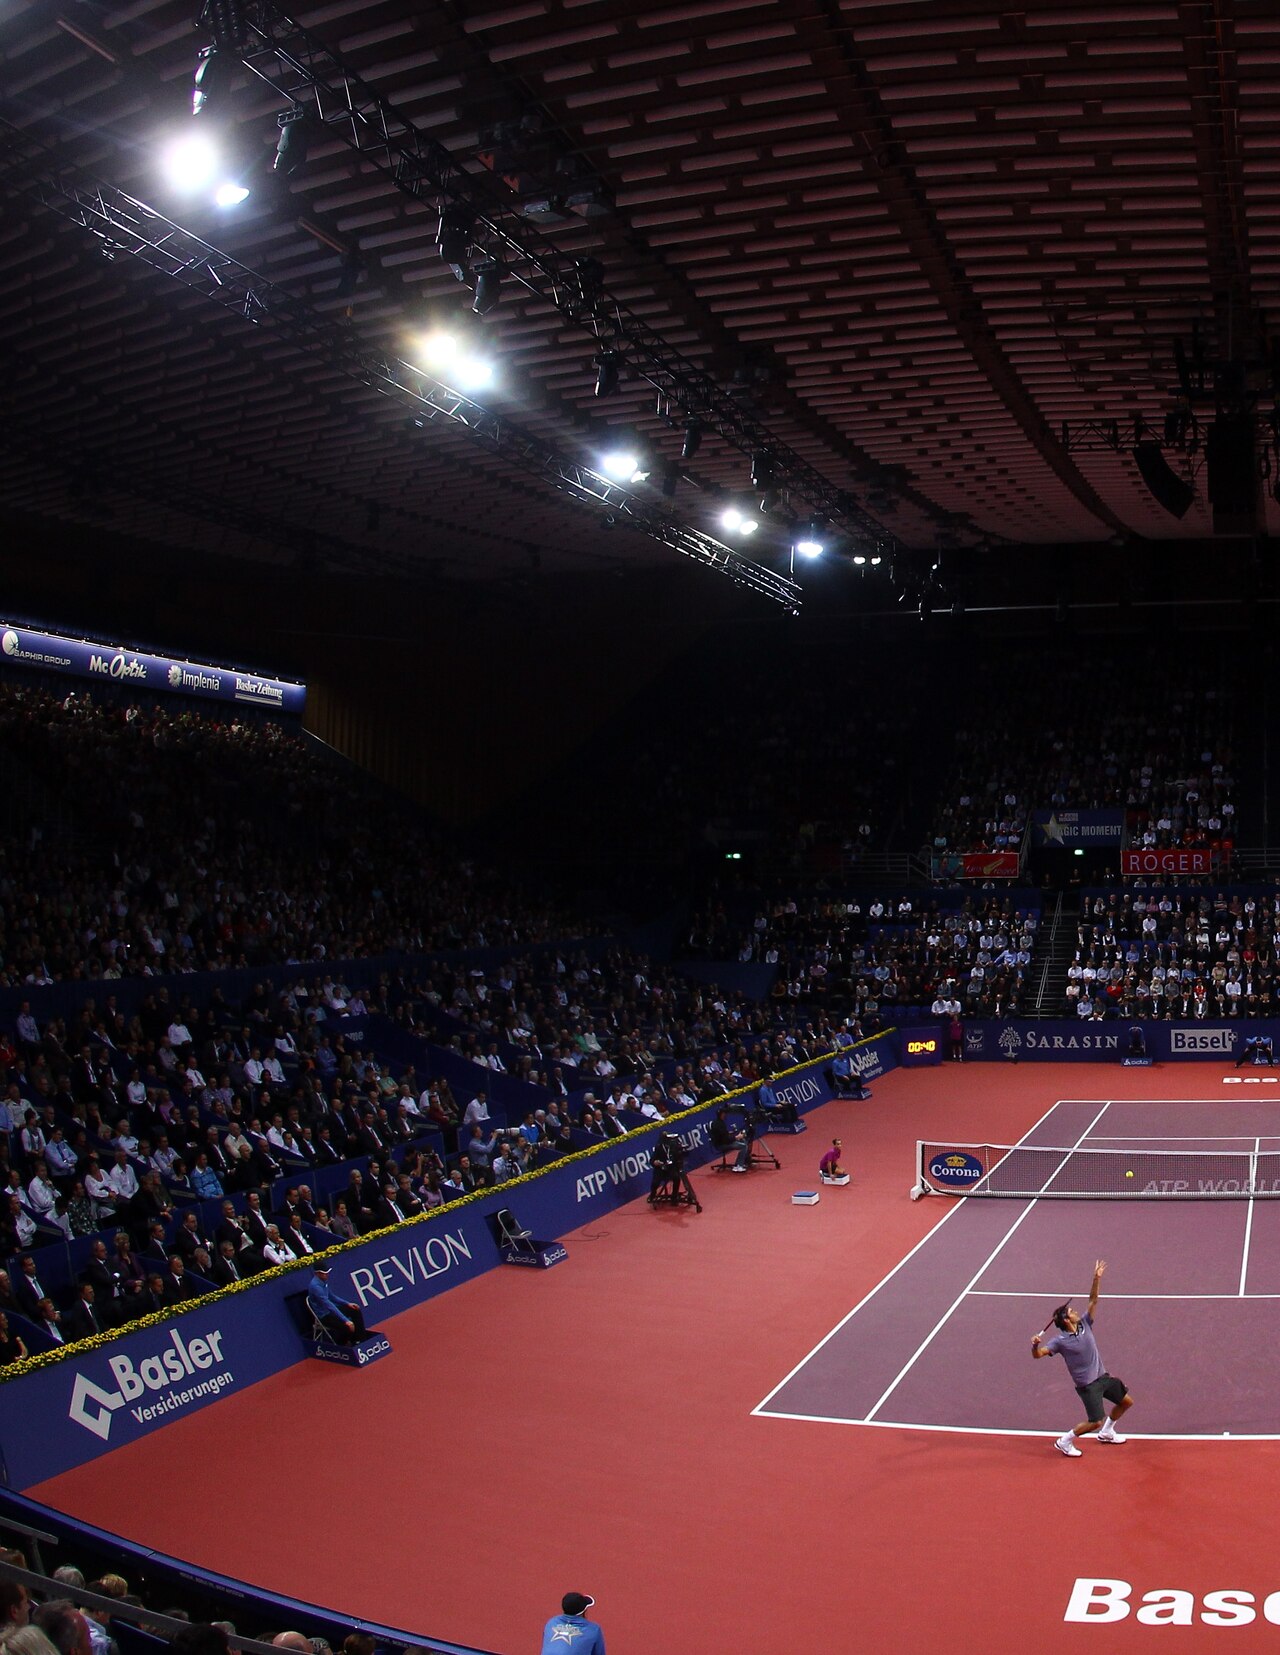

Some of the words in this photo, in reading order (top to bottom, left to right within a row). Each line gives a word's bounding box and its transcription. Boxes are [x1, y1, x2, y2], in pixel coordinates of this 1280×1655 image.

[13, 650, 43, 662] SAPHIR
[44, 655, 72, 666] GROUP
[182, 669, 221, 691] Implenia
[1081, 825, 1122, 837] MOMENT
[1130, 854, 1204, 871] ROGER
[907, 1040, 936, 1053] 00:40
[1174, 1031, 1228, 1049] Basel
[577, 1170, 608, 1203] ATP
[606, 1146, 656, 1186] WORL
[930, 1164, 981, 1177] Corona
[349, 1229, 473, 1307] REVLON
[109, 1327, 224, 1403] Basler
[131, 1370, 234, 1425] Versicherungen
